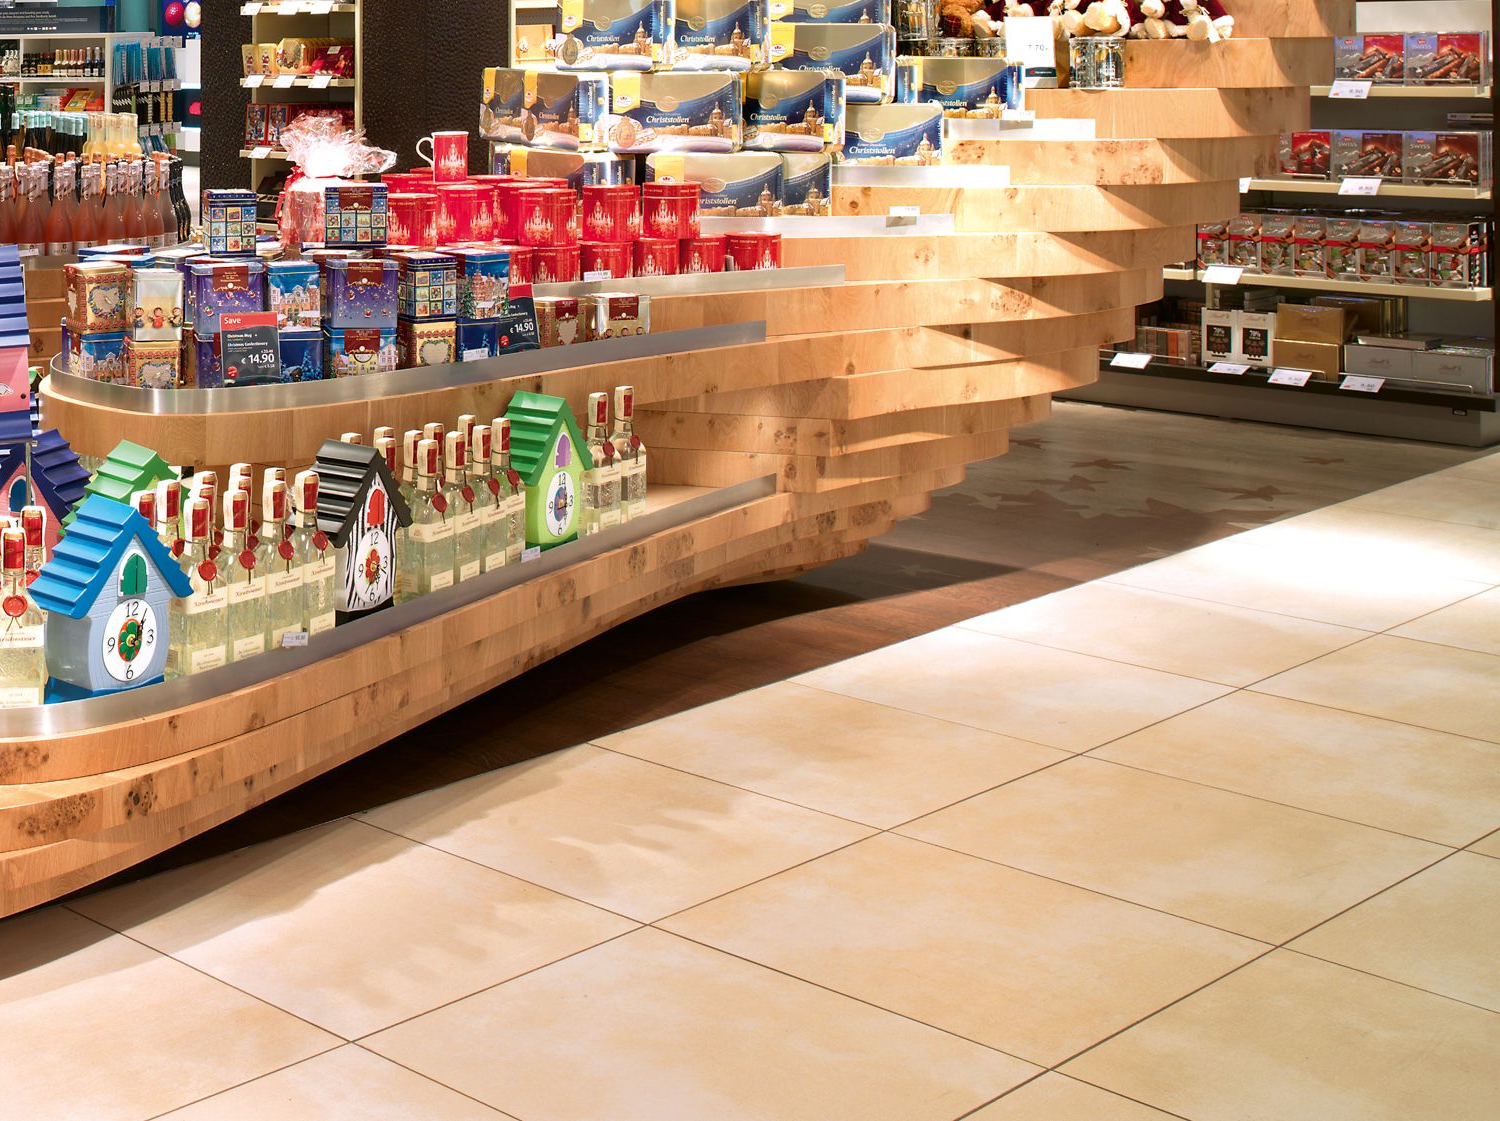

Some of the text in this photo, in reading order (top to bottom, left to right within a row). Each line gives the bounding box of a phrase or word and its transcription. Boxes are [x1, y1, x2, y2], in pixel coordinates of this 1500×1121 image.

[586, 34, 620, 43] Christstollen
[680, 34, 716, 43] Christstollen
[646, 115, 691, 124] Christstollen
[750, 113, 787, 122] Christstollen
[849, 146, 896, 155] Christstollen
[699, 197, 738, 205] riststollen
[514, 322, 534, 333] 14.90
[248, 353, 275, 364] 14.90
[369, 531, 379, 546] 12
[383, 556, 388, 569] 3
[358, 563, 364, 578] 9
[369, 590, 376, 602] 6
[125, 601, 139, 618] 12
[147, 629, 155, 644] 3
[107, 637, 116, 653] 9
[126, 664, 134, 680] 6
